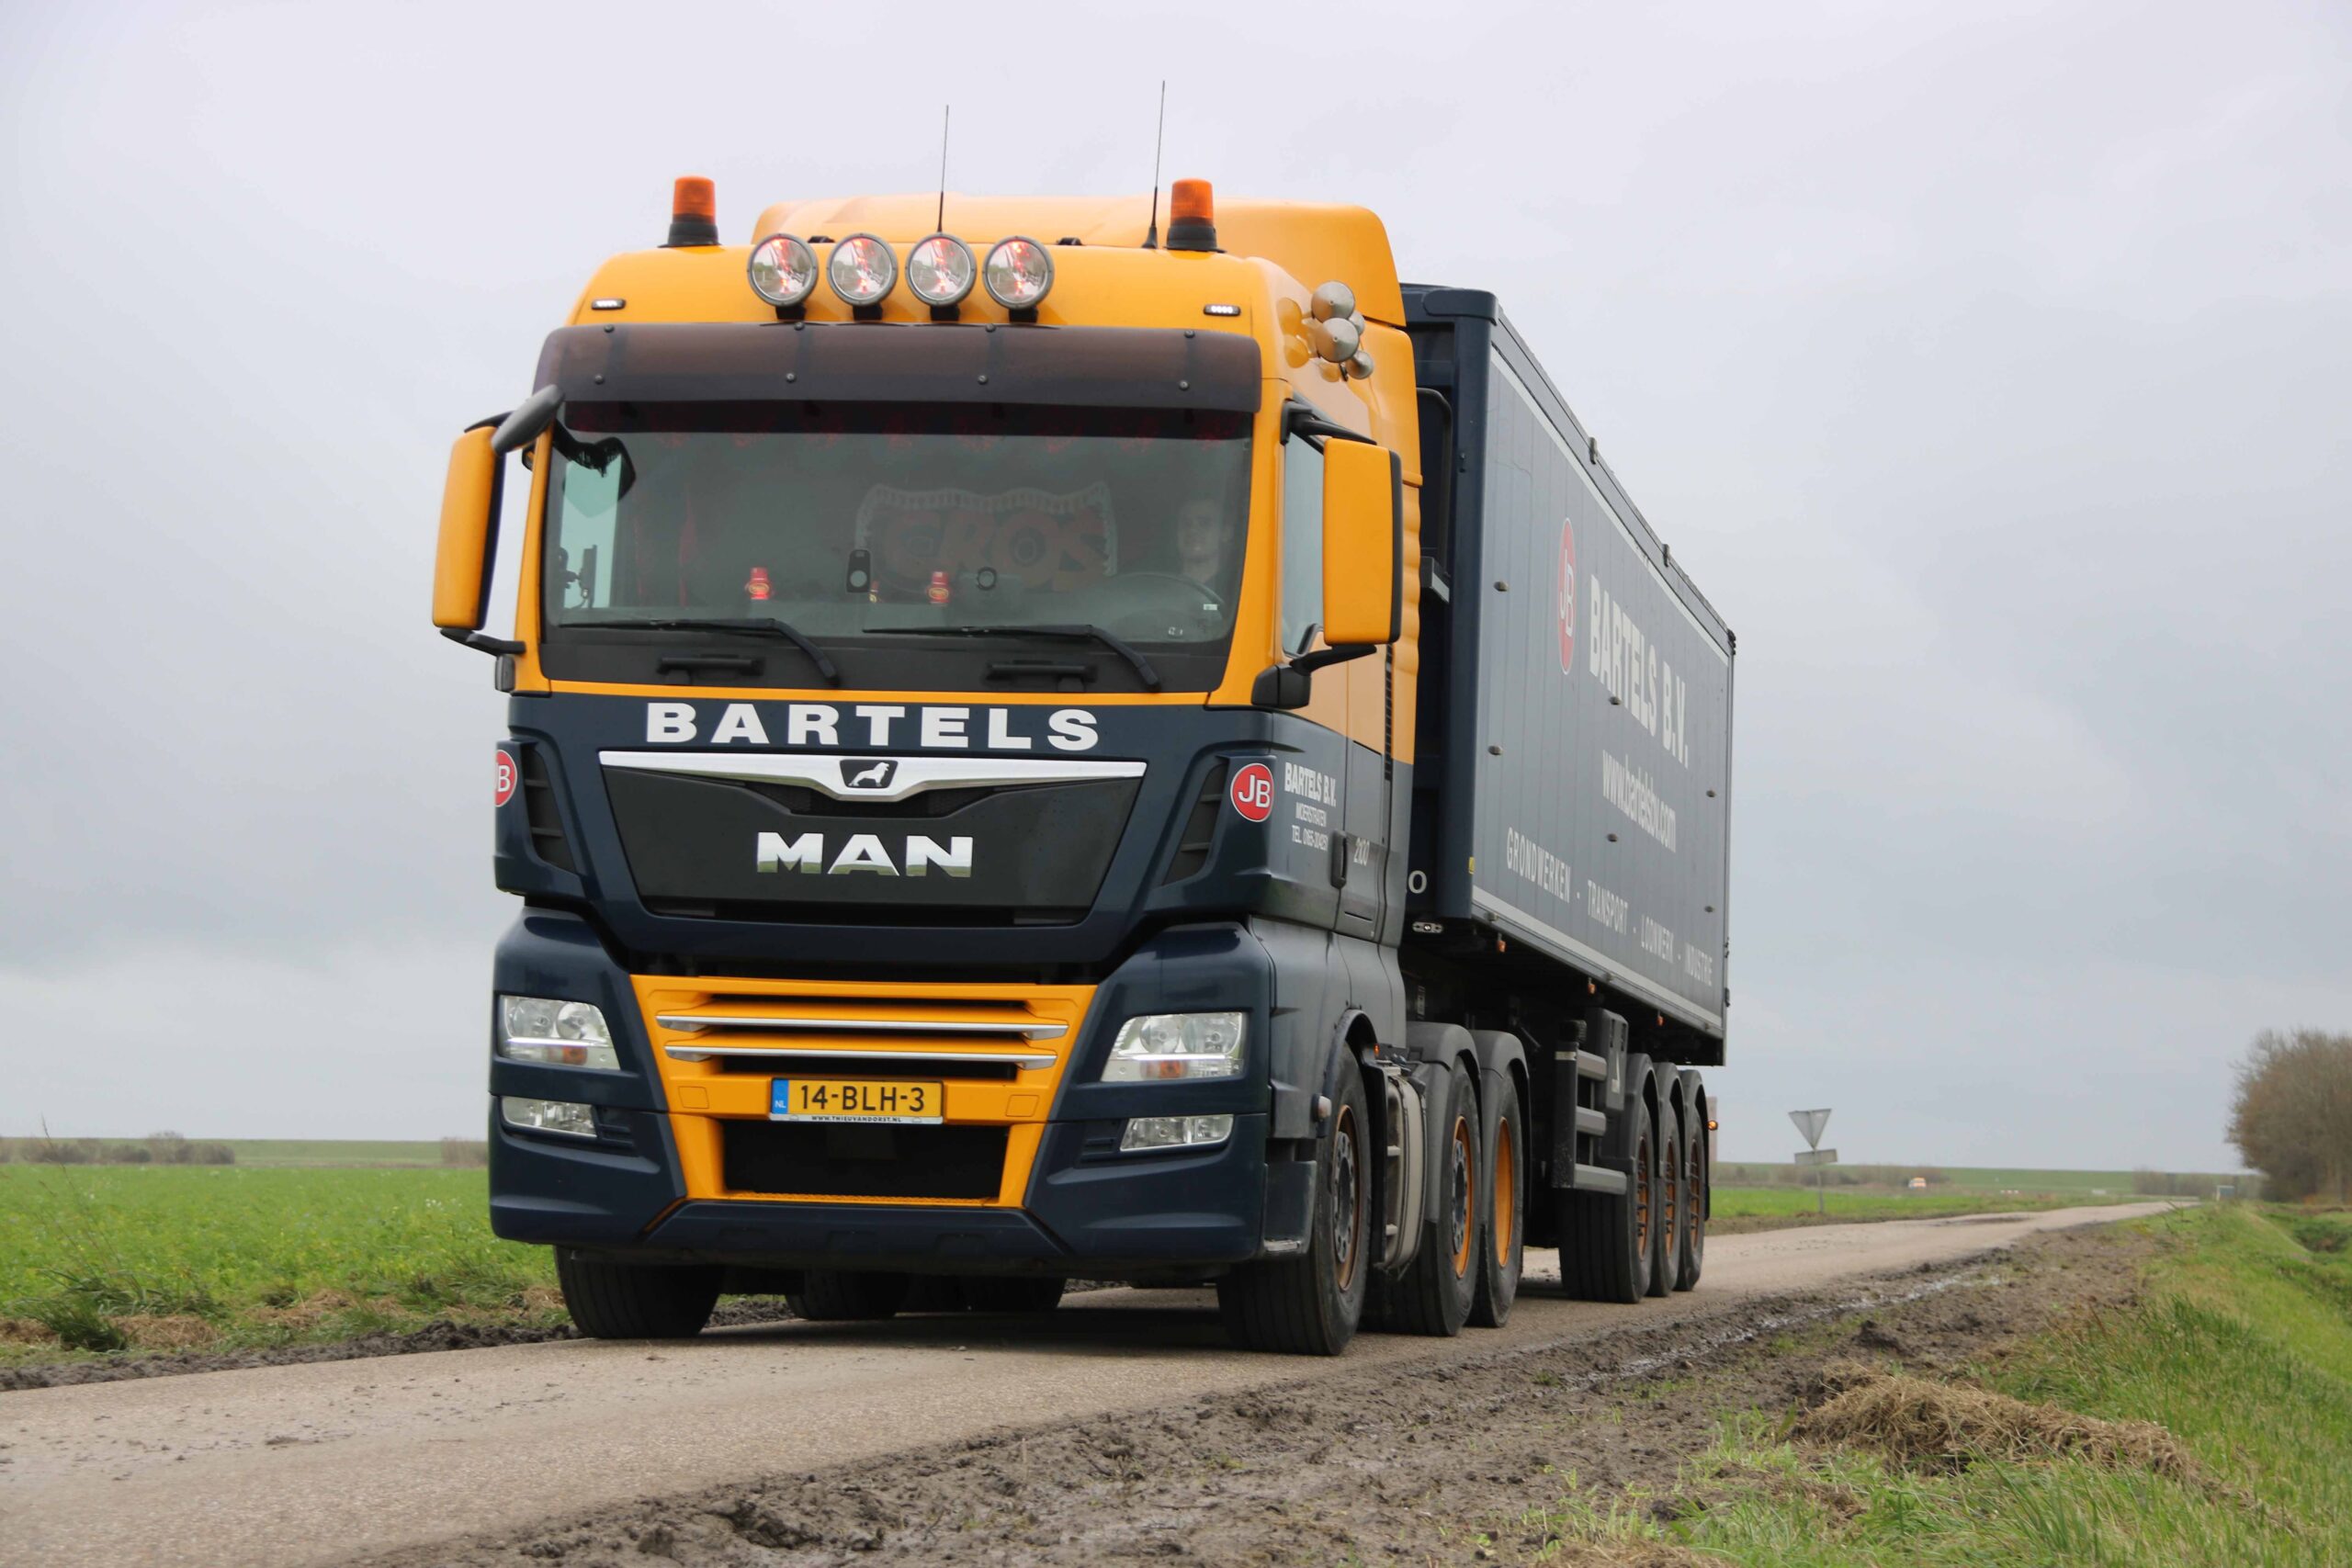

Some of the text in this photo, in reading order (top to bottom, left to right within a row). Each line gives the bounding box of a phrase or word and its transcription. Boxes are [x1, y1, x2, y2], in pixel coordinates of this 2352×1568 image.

[1560, 547, 1574, 637] JB
[1589, 573, 1689, 770] BARTELS B.V.
[646, 702, 1099, 751] BARTELS
[1238, 774, 1271, 808] JB
[1284, 761, 1337, 807] BARTELS B.V.
[756, 831, 973, 878] MAN
[1507, 827, 1571, 904] GRONDWERKEN
[1588, 879, 1629, 936] TRANSPORT
[775, 1084, 925, 1112] NL 14-BLH-3
